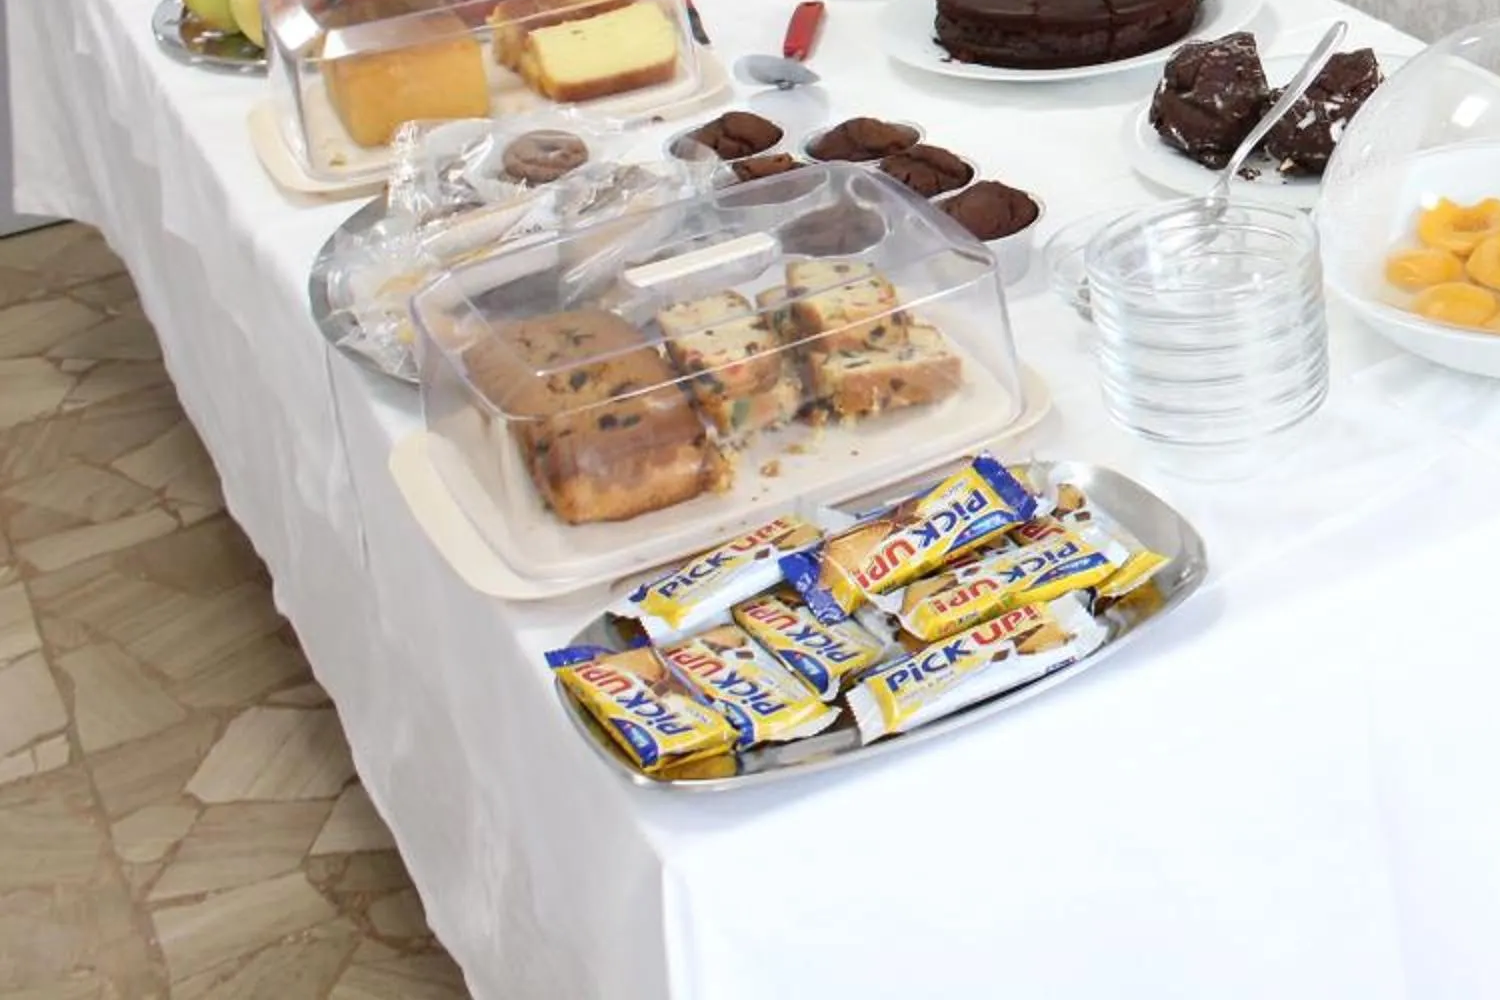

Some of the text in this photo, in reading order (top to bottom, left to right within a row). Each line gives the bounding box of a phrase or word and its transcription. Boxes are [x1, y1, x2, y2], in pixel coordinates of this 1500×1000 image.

[854, 539, 916, 589] UP!
[931, 578, 1000, 613] UP!
[971, 604, 1039, 646] UP!
[575, 663, 633, 695] UP!
